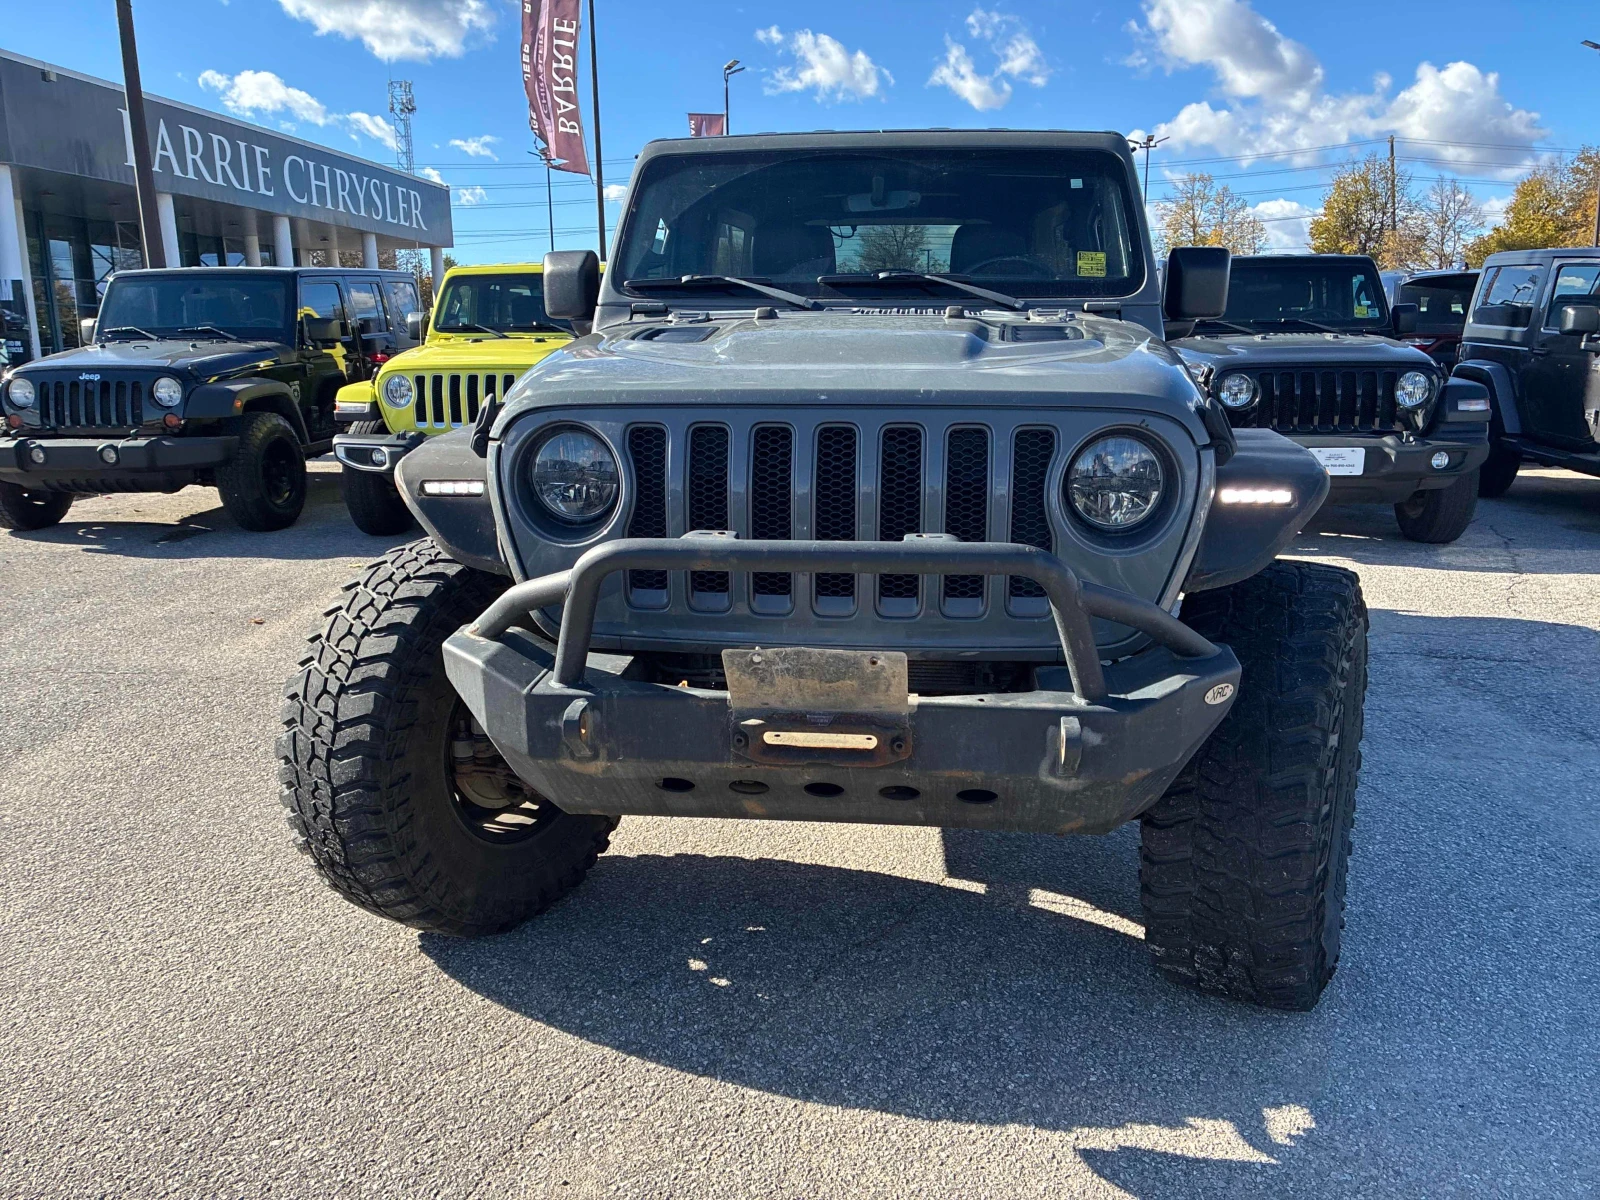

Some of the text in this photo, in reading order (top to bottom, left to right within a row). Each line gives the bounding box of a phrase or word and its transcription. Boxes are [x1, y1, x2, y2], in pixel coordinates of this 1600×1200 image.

[283, 154, 428, 231] CHRYSLER
[78, 372, 101, 381] Jeep
[1209, 684, 1230, 702] XRC
